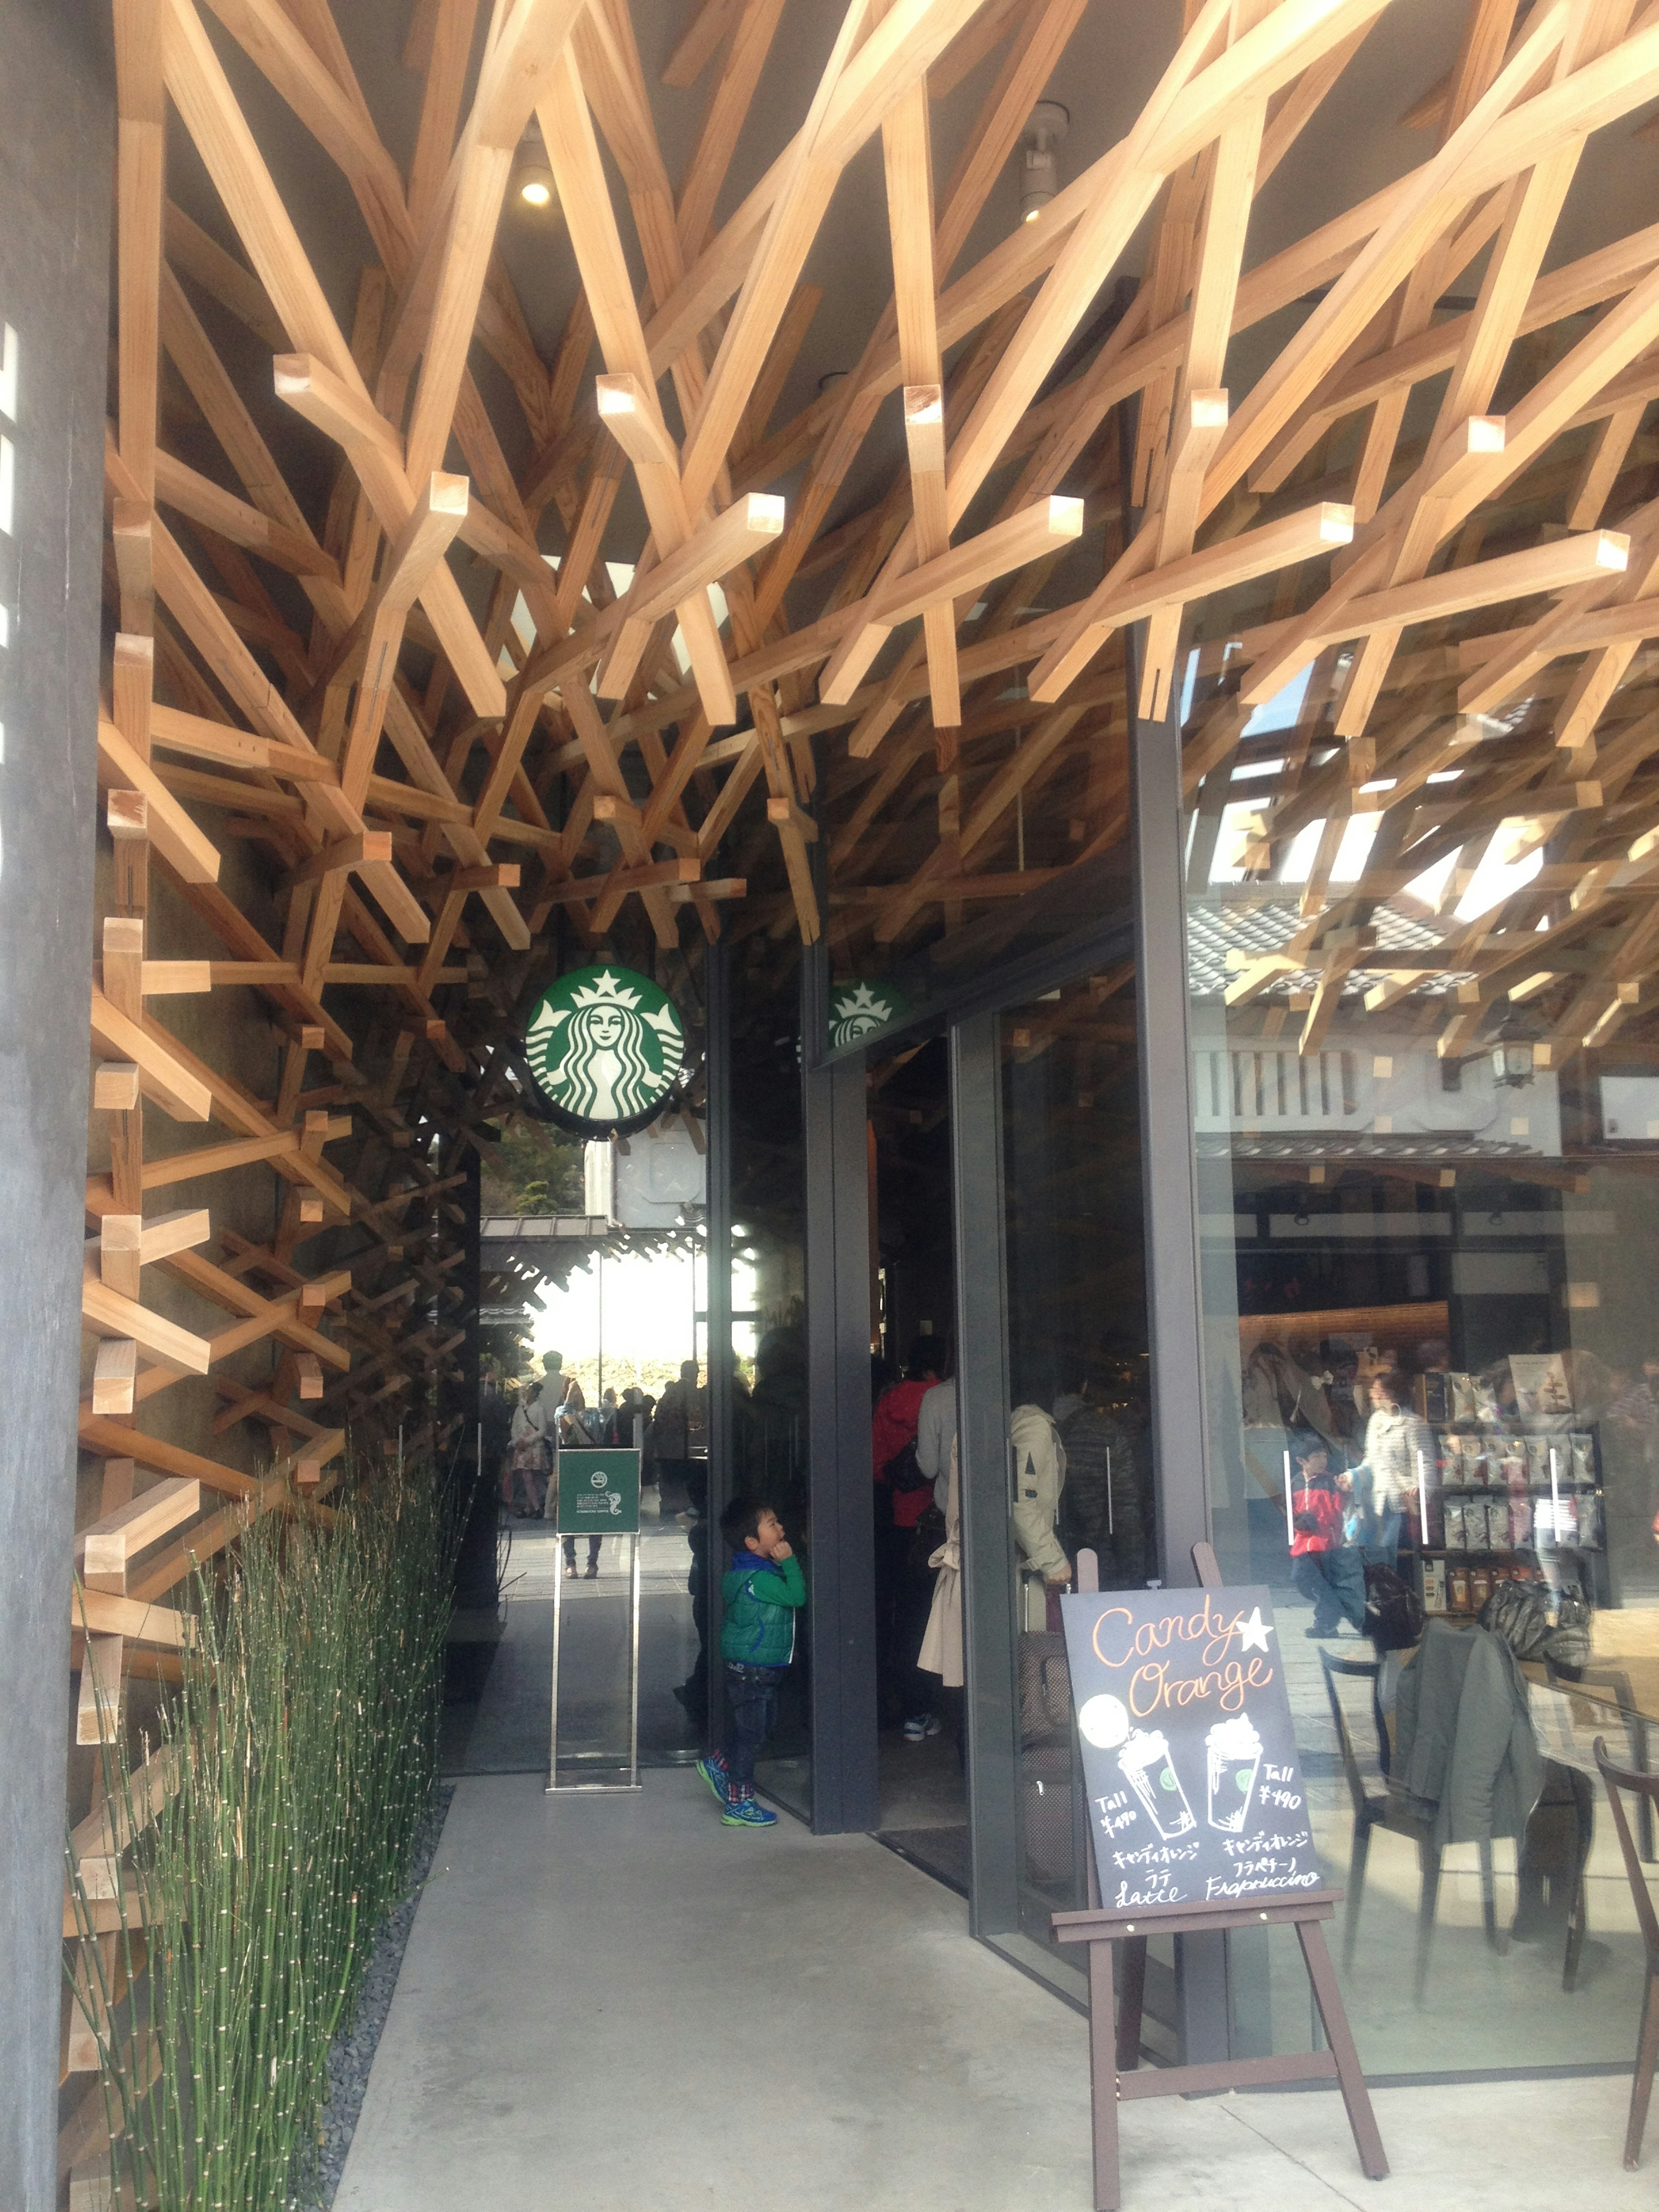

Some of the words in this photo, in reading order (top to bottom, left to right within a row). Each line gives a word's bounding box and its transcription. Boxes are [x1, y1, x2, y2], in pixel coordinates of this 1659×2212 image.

[1092, 1594, 1249, 1668] Candy
[1129, 1658, 1273, 1717] Orange
[1263, 1764, 1294, 1782] Tall
[1095, 1790, 1128, 1813] Tall
[1259, 1785, 1301, 1810] ¥490
[1112, 1841, 1199, 1869] キャンディオレンジ
[1222, 1831, 1308, 1856] キャンディオレンジ
[1145, 1869, 1171, 1888] ラテ
[1233, 1857, 1296, 1877] フラペチーノ
[1115, 1880, 1187, 1908] Latte
[1206, 1870, 1320, 1901] Frappuccino
